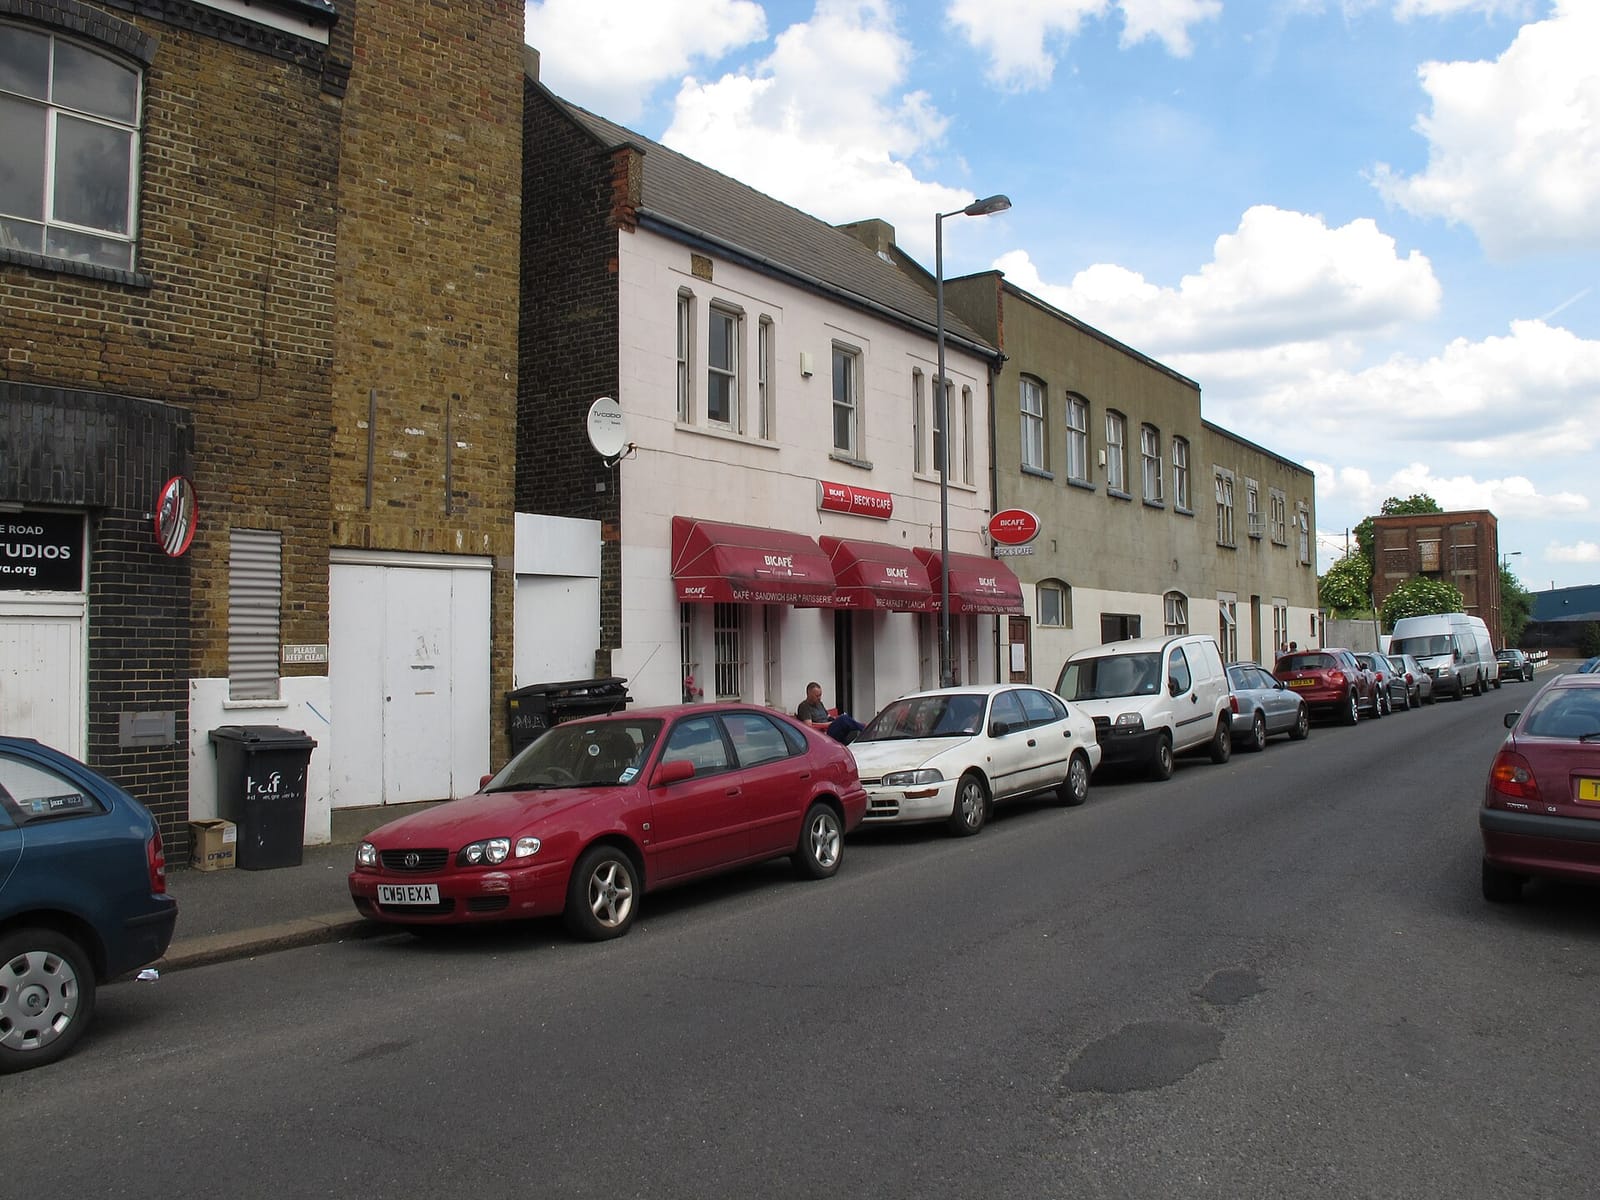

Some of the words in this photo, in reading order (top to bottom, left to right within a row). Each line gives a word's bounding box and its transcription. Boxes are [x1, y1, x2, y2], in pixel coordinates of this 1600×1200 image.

[854, 494, 875, 507] BECK'S
[8, 525, 44, 535] ROAD
[755, 591, 785, 601] SANDWICH
[293, 646, 317, 654] PLEASE
[383, 887, 406, 901] CW51
[408, 886, 431, 901] EXA
